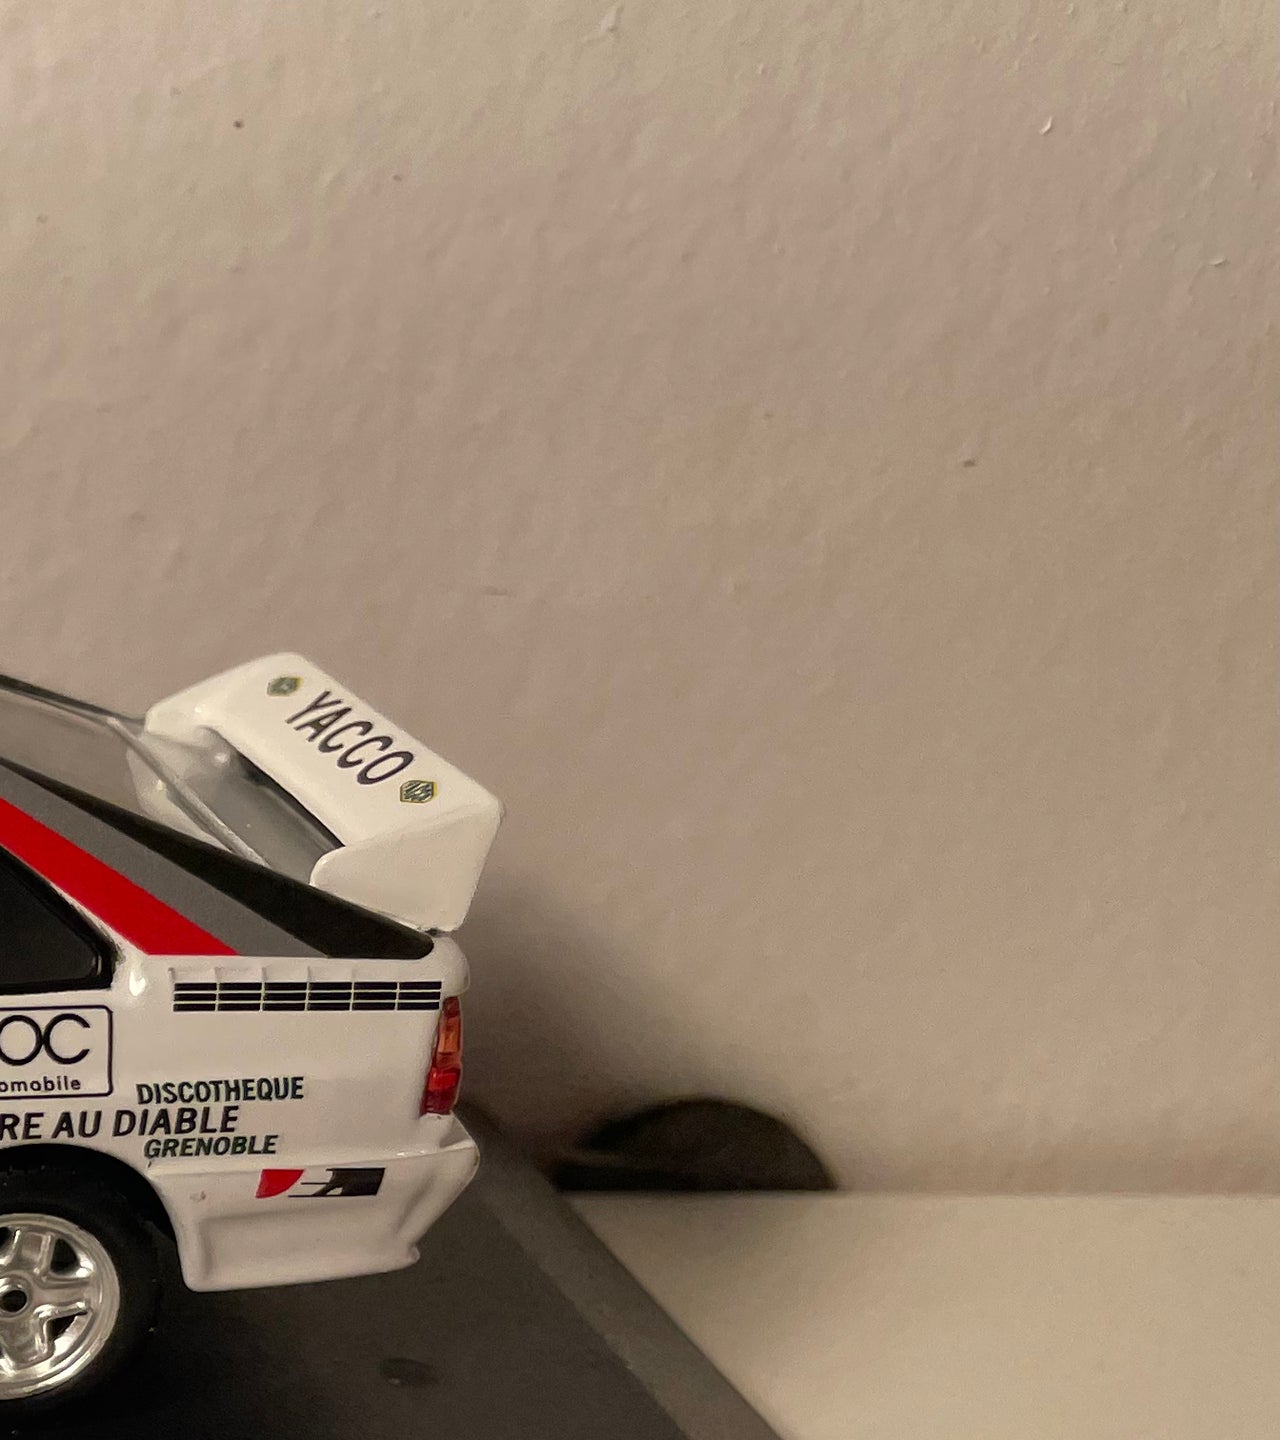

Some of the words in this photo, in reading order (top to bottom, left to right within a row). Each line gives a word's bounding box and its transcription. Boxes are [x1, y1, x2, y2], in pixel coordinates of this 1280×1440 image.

[284, 690, 416, 786] YACCO
[136, 1075, 305, 1106] DISCOTHEQUE
[51, 1109, 107, 1139] AU
[113, 1104, 240, 1138] DIABLE
[143, 1133, 278, 1160] GRENOBLE
